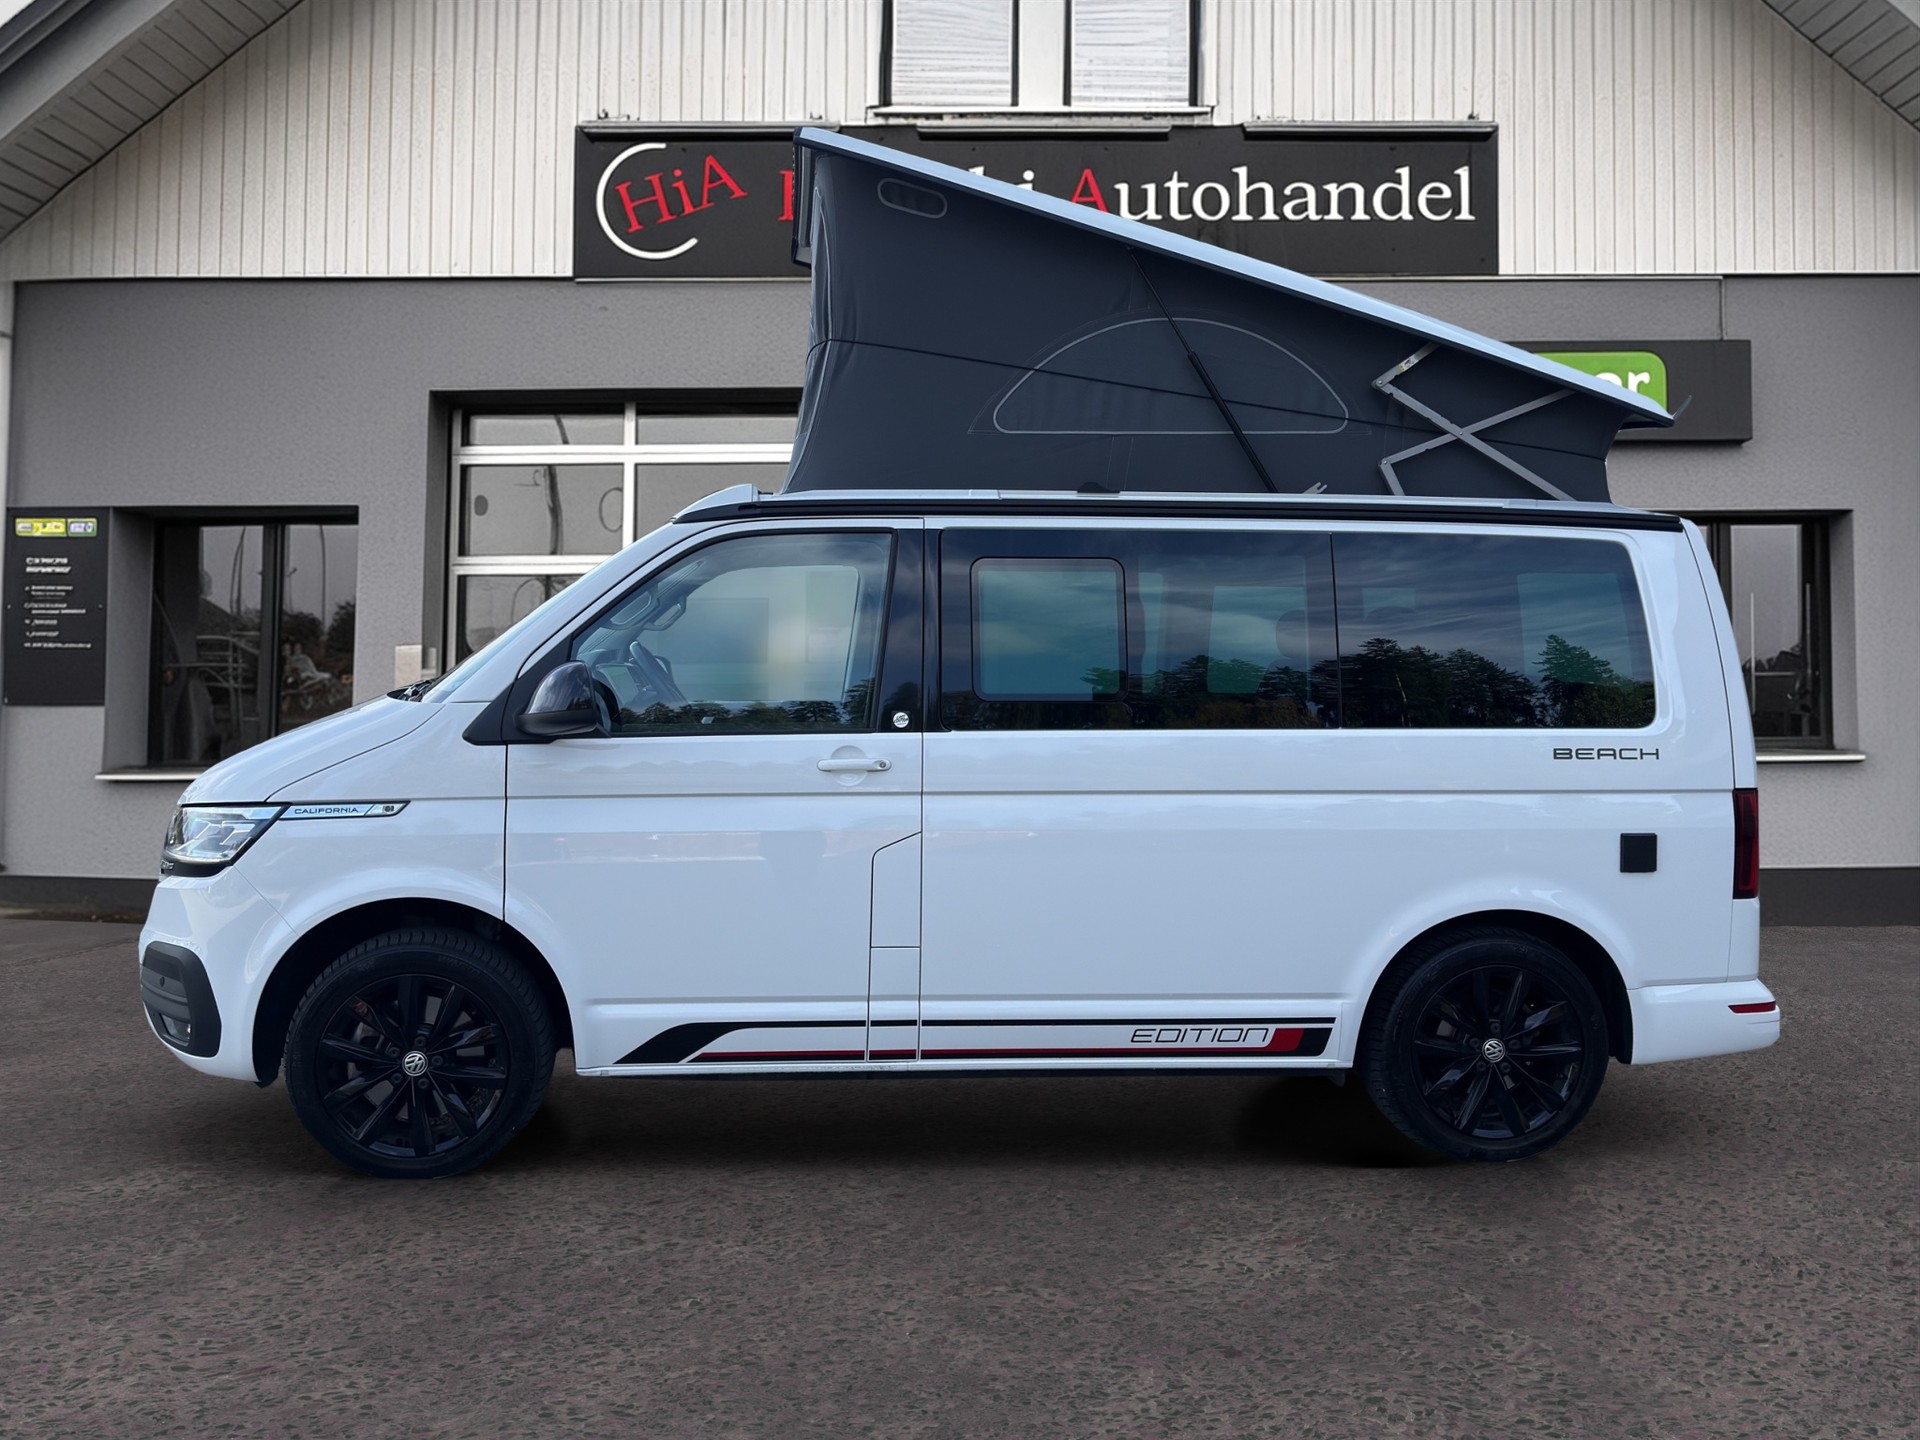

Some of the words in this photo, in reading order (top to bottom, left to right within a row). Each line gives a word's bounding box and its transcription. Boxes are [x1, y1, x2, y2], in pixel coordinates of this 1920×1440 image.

[615, 154, 749, 235] HiA
[1070, 165, 1477, 222] Autohandel
[1552, 747, 1660, 761] BEACH
[294, 807, 359, 815] CALIFORNIA
[1130, 1027, 1270, 1044] EDITION
